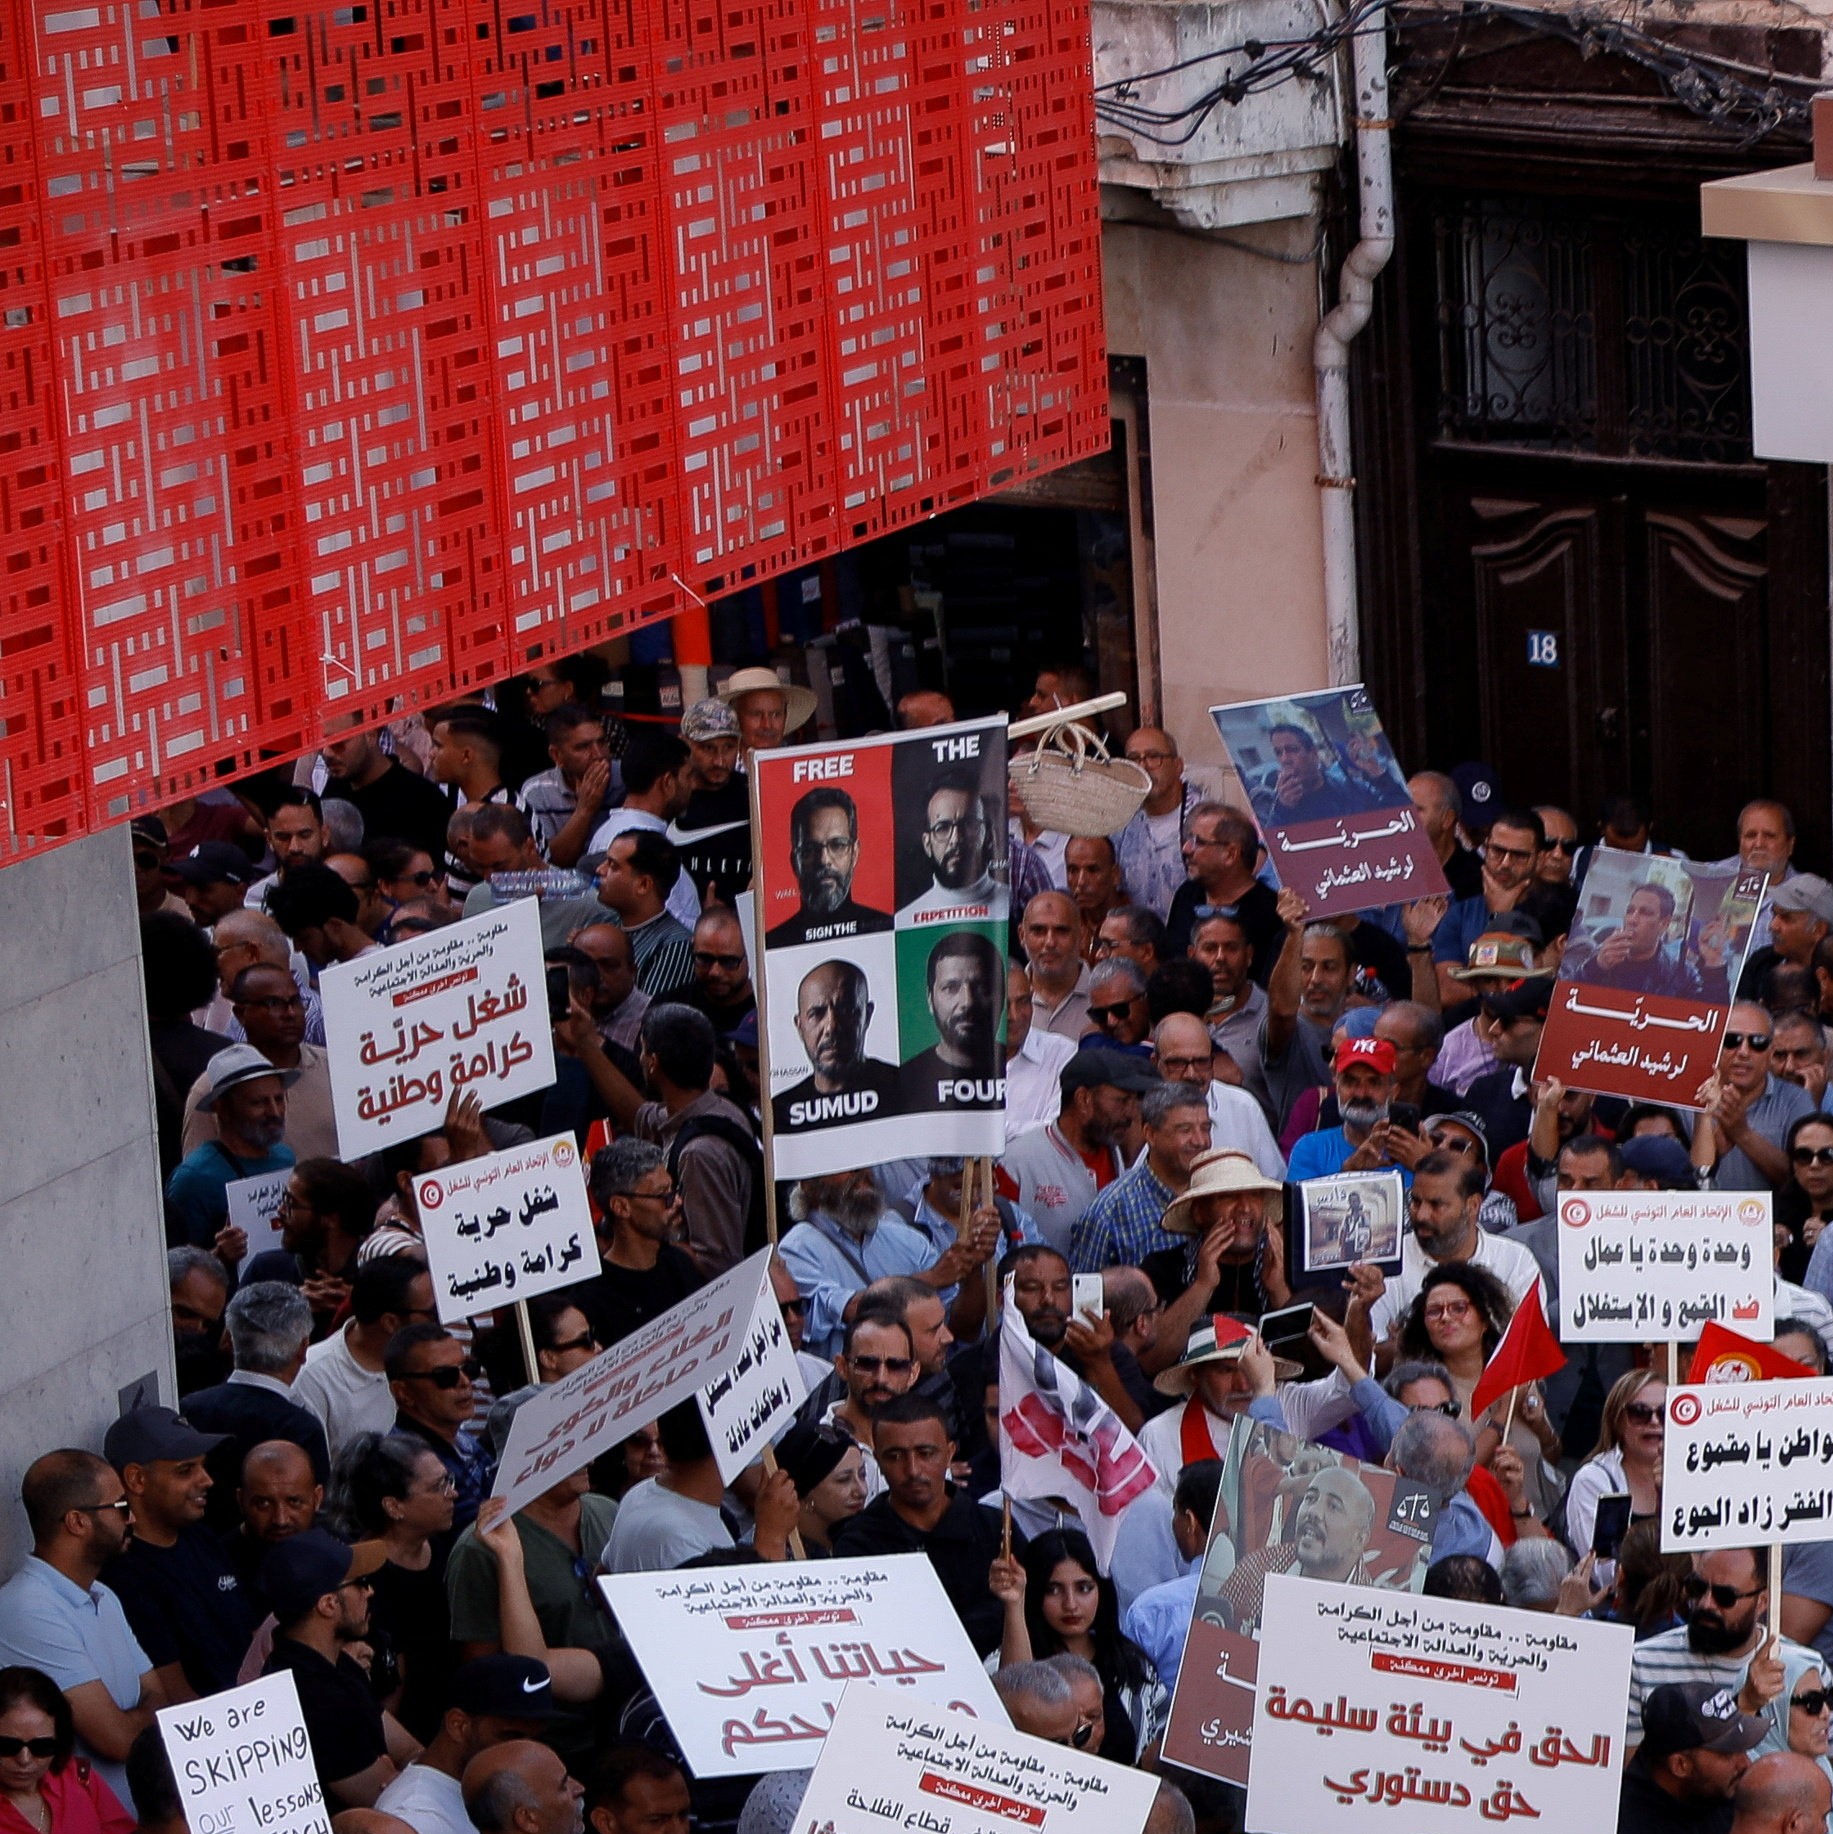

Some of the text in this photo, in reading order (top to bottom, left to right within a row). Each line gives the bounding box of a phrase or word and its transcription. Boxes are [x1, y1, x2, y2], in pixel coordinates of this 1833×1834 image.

[1528, 633, 1558, 665] 18
[932, 736, 980, 763] THE
[793, 755, 854, 783] FREE
[452, 972, 527, 1041] شغل
[357, 1030, 533, 1126] كرامة وطنية
[789, 1090, 878, 1126] SUMUD
[454, 1206, 512, 1243] حرية
[447, 1233, 582, 1302] كرامة وطنية
[1584, 1235, 1751, 1272] وحدة وحدة يا عمال
[1678, 1293, 1725, 1329] القمع
[1731, 1293, 1760, 1320] ضد
[1686, 1433, 1751, 1473] مقموع
[1756, 1430, 1772, 1470] يا
[1672, 1496, 1731, 1537] الجوع
[1738, 1495, 1773, 1531] زاد
[1778, 1489, 1833, 1531] الفقر
[696, 1631, 808, 1698] أغلى
[174, 1699, 265, 1742] We are
[1265, 1685, 1611, 1769] الحق في بيئة سليمة
[846, 1794, 904, 1821] الفلاحة
[1323, 1766, 1541, 1822] حق دستوري
[903, 1810, 950, 1834] قطاع
